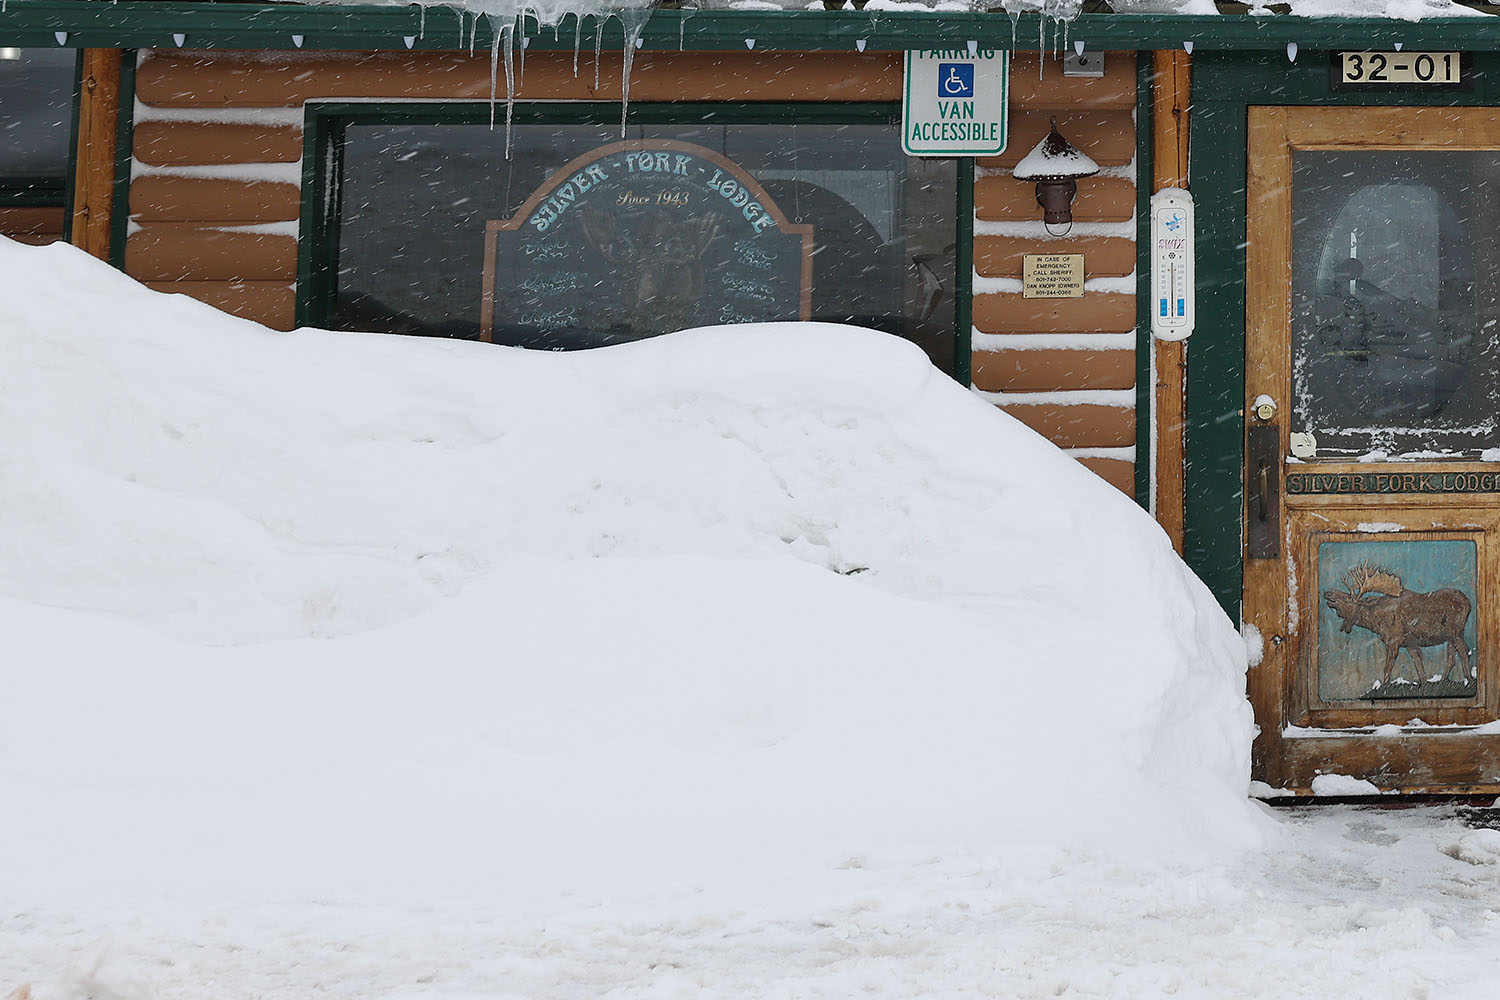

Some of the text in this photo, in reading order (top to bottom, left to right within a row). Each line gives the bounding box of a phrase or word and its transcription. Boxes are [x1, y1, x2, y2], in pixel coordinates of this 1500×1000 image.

[1346, 54, 1451, 81] 32-01
[938, 101, 974, 119] VAN
[912, 122, 998, 141] ACCESSIBLE
[530, 152, 774, 233] SILVER FORK LODGE
[615, 190, 690, 206] Since 1943
[1289, 473, 1367, 493] SILVER
[1375, 474, 1436, 492] FORK
